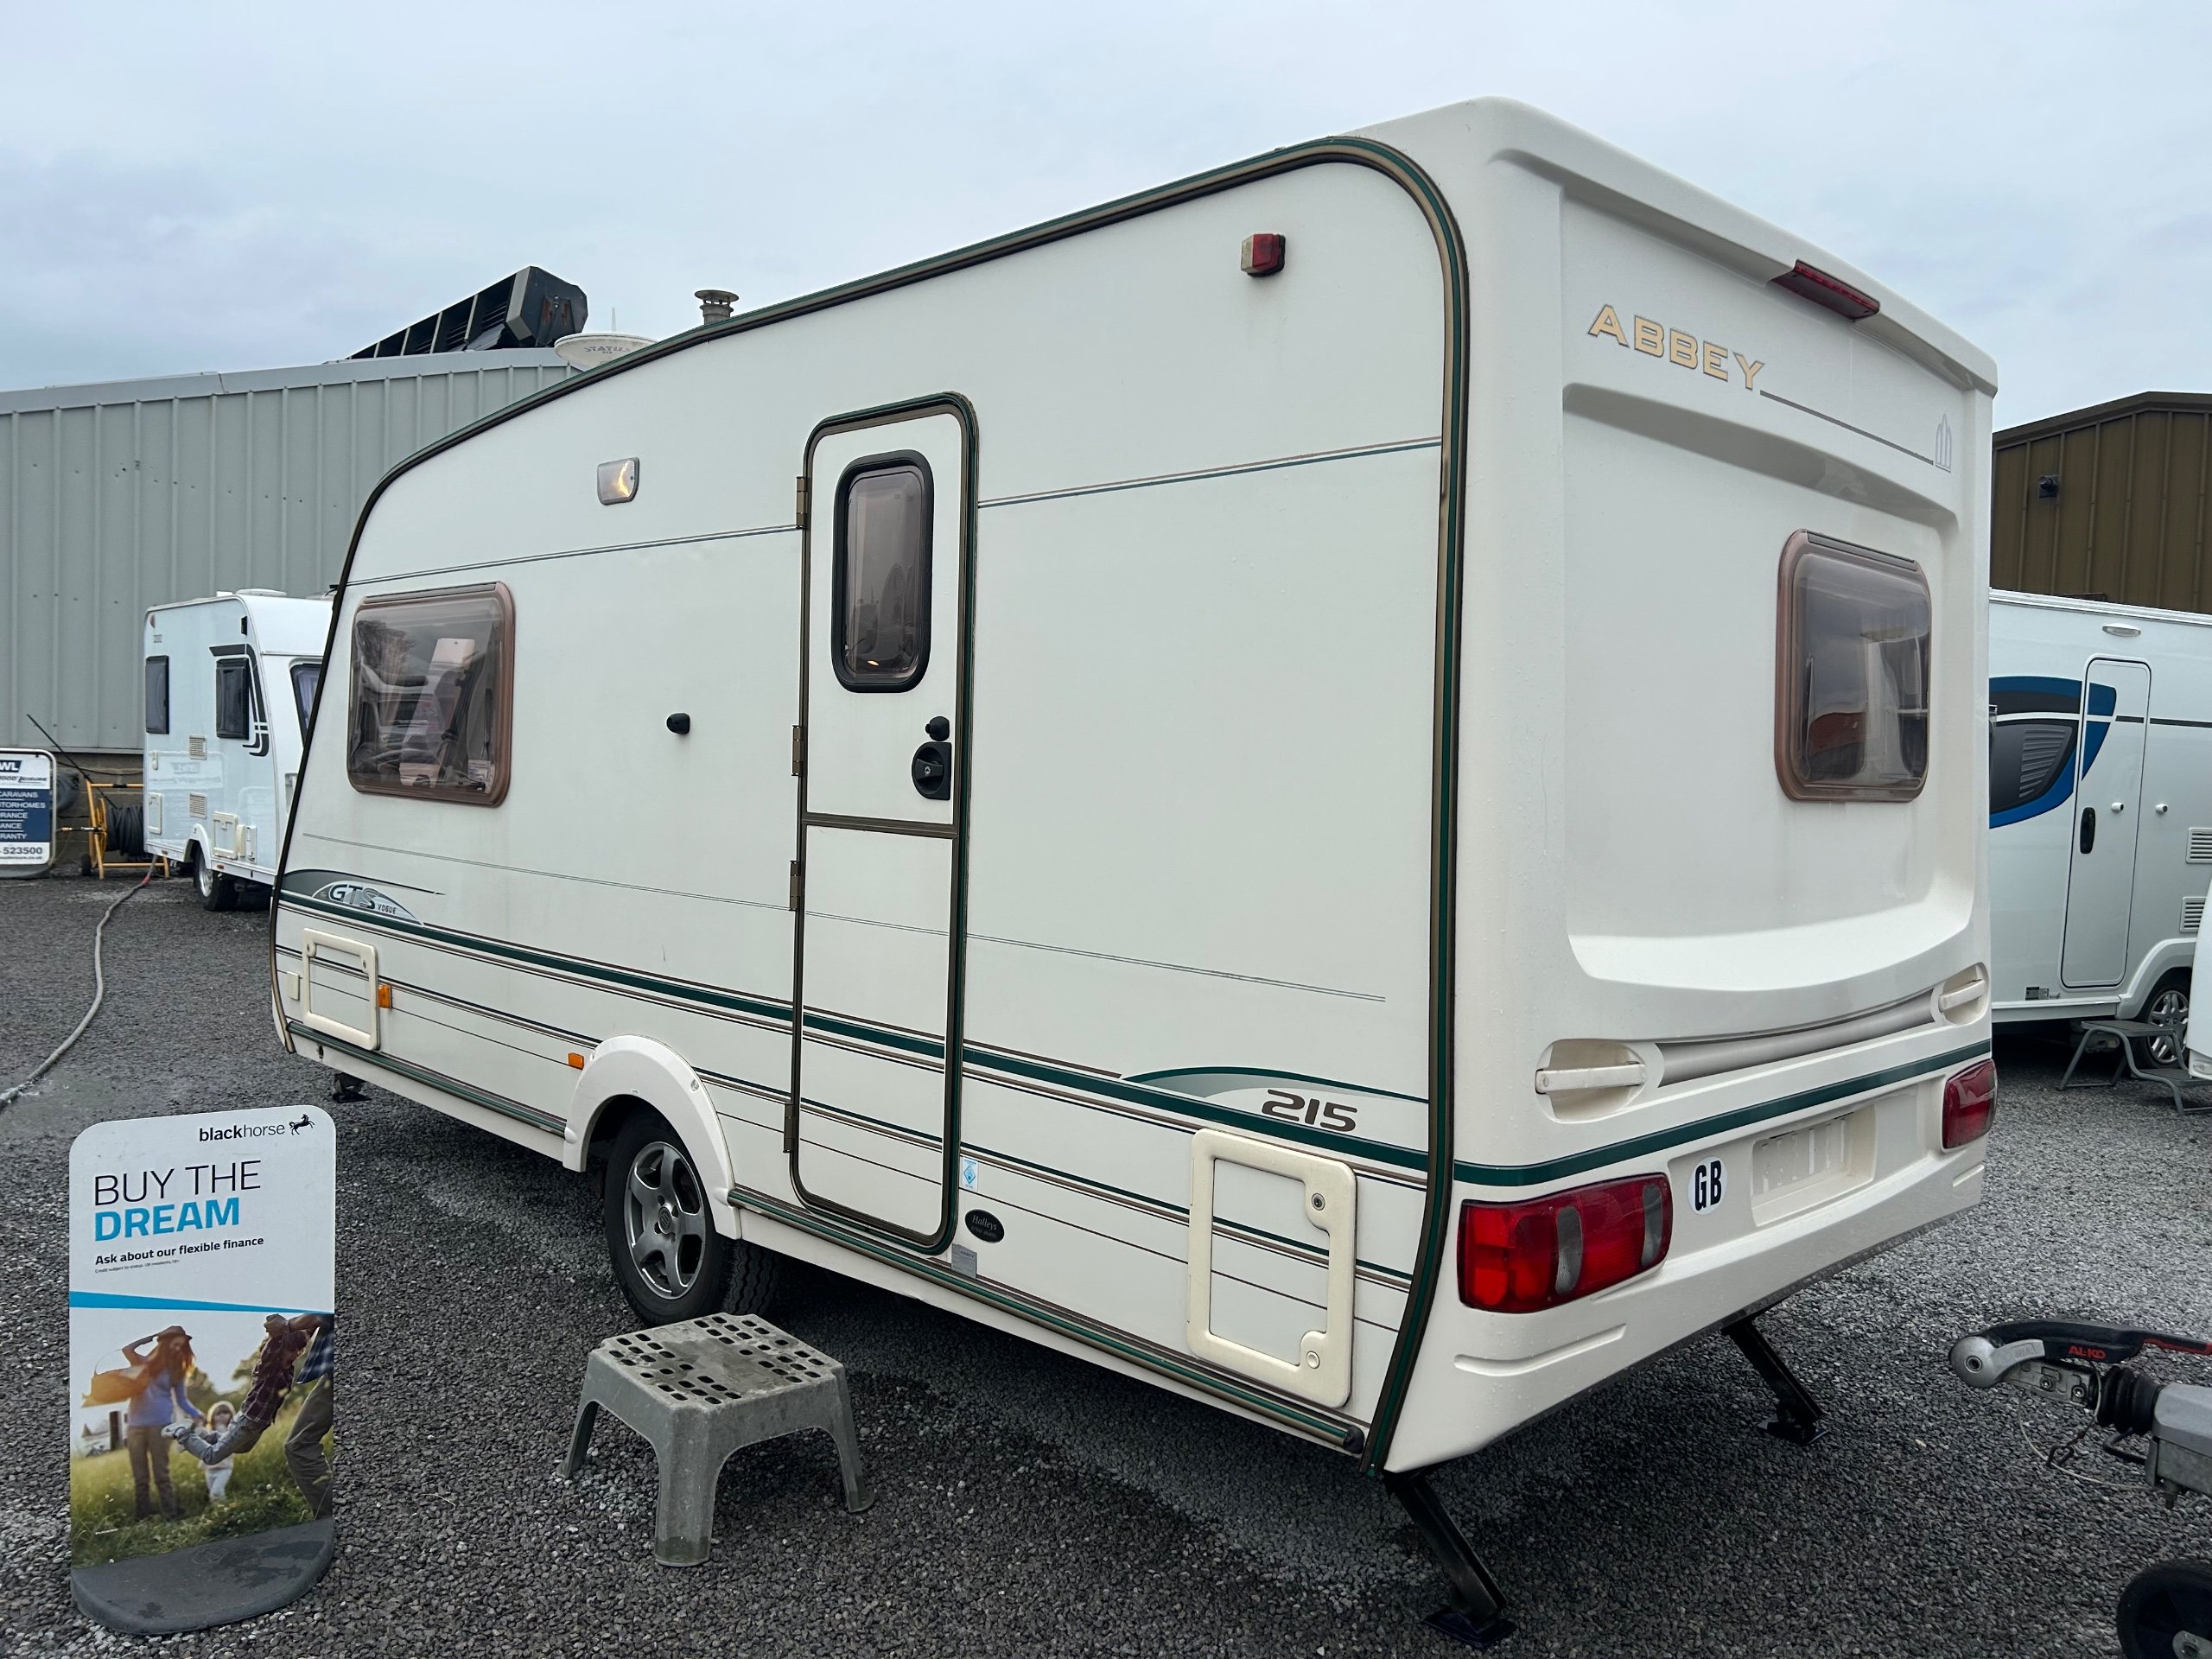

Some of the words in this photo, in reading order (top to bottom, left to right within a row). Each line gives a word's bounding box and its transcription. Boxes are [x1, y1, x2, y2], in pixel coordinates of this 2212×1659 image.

[1588, 304, 1765, 391] ABBEY
[329, 884, 378, 909] GTS
[378, 903, 397, 914] VOGUE
[1262, 1089, 1357, 1132] 215
[199, 1123, 285, 1142] blackhorse
[95, 1168, 175, 1206] BUY
[184, 1160, 262, 1196] THE
[1694, 1160, 1722, 1211] GB
[95, 1197, 239, 1242] DREAM
[972, 1215, 997, 1230] Halleys
[95, 1253, 118, 1265] Ask
[119, 1249, 155, 1262] about
[156, 1247, 176, 1257] our
[179, 1241, 221, 1255] flexible
[223, 1237, 264, 1249] finance
[2068, 1344, 2107, 1359] AL-KO
